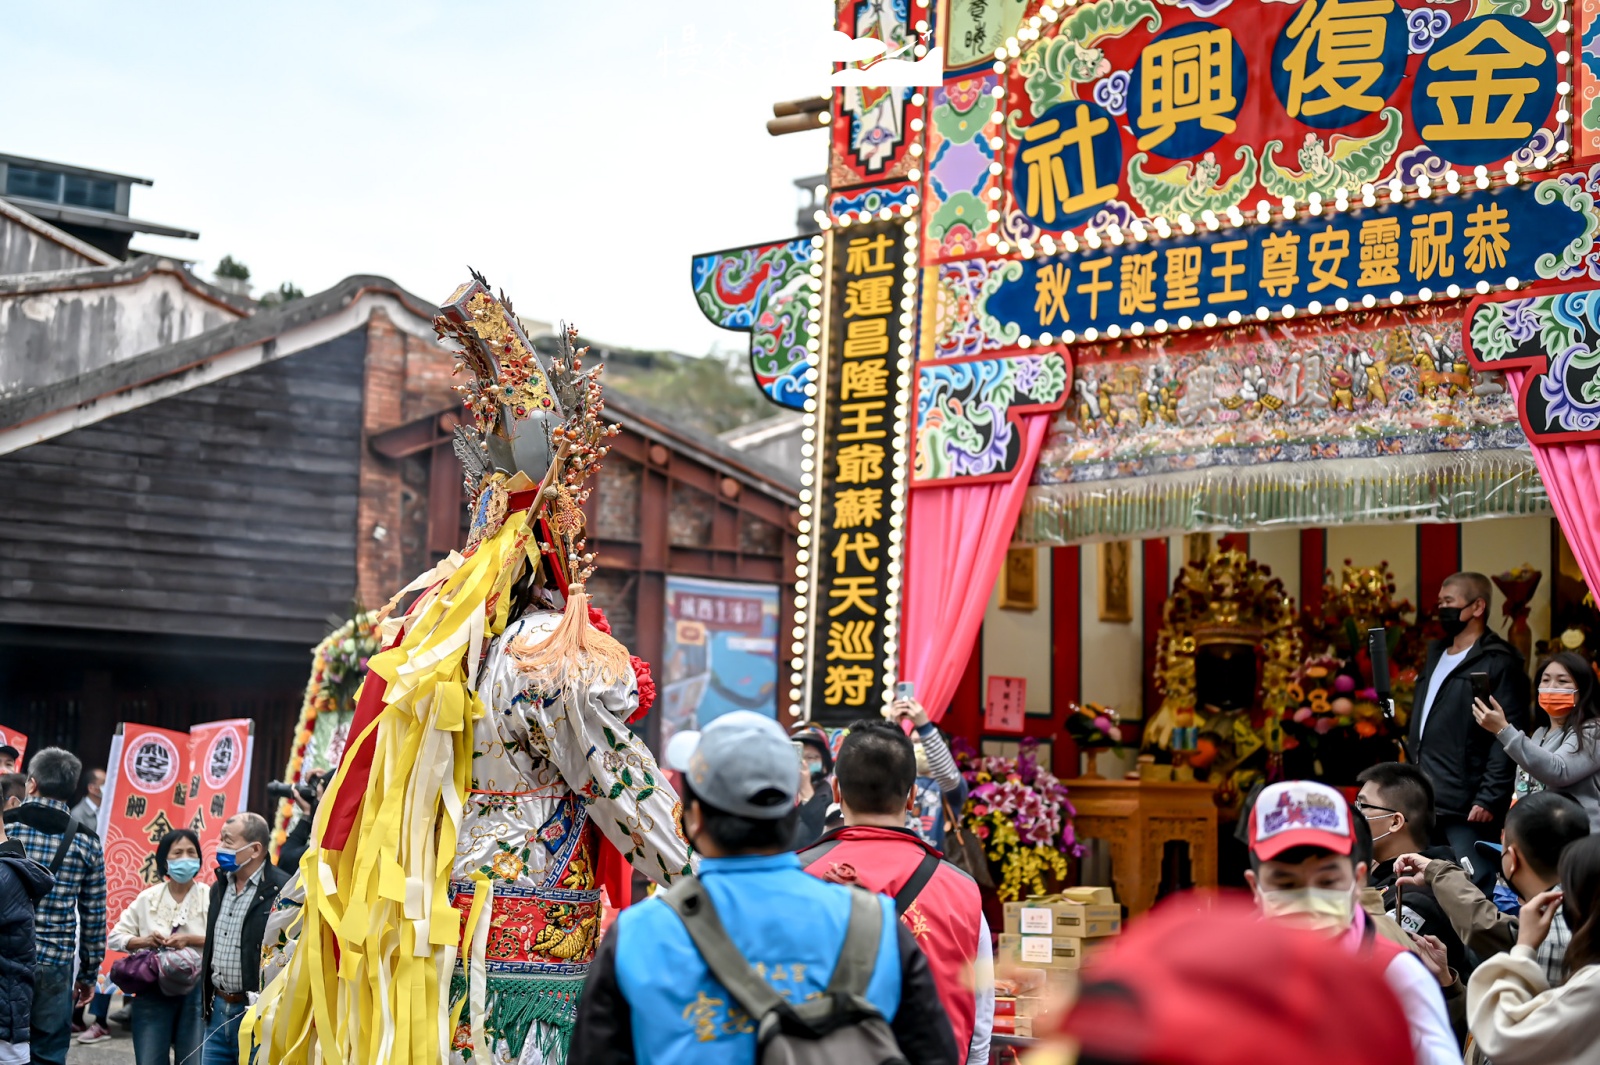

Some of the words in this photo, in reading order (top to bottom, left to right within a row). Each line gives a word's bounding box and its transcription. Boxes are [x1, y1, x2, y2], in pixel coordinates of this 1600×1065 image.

[1021, 0, 1547, 223] 金復興社
[1034, 203, 1510, 326] 恭祝靈安尊王聖誕千秋
[824, 234, 895, 706] 社運昌隆王爺蘇代天巡狩
